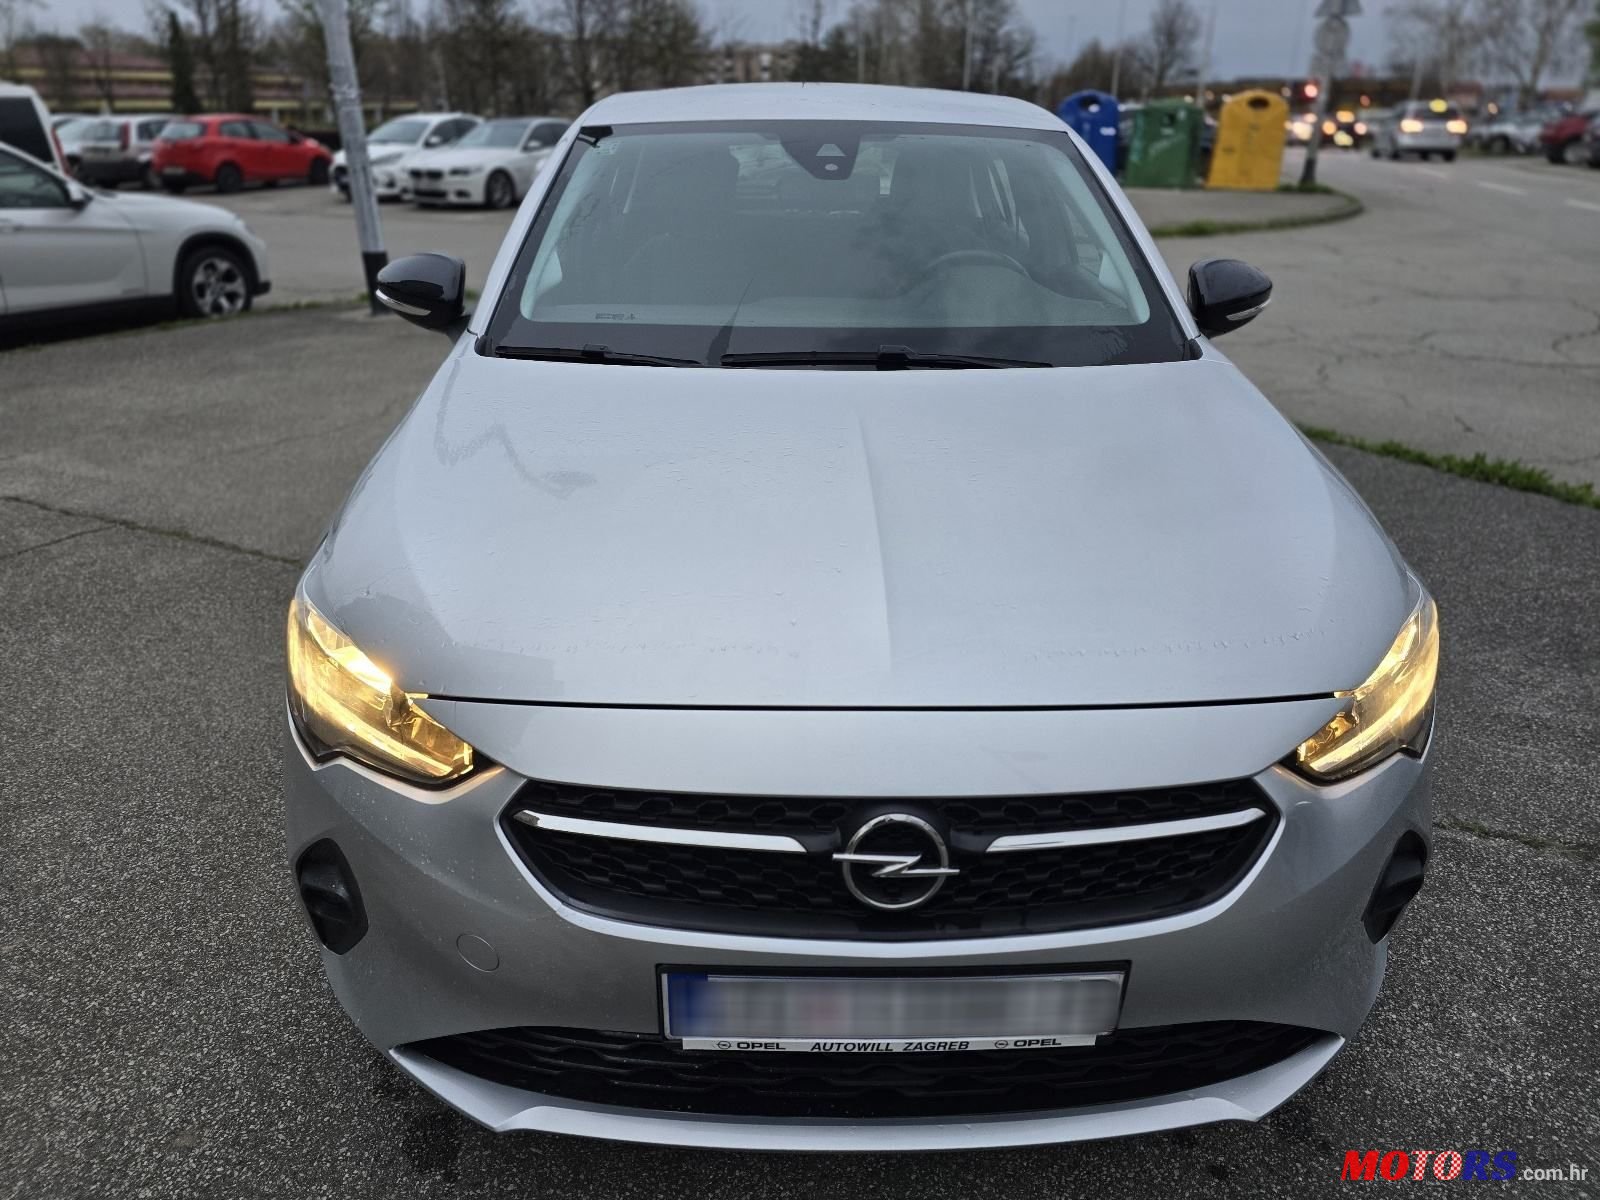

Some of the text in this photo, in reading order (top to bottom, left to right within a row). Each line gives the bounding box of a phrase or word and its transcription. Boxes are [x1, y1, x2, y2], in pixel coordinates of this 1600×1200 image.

[736, 1037, 1062, 1053] OPEL AUTOWILL ZAGREB OPEL
